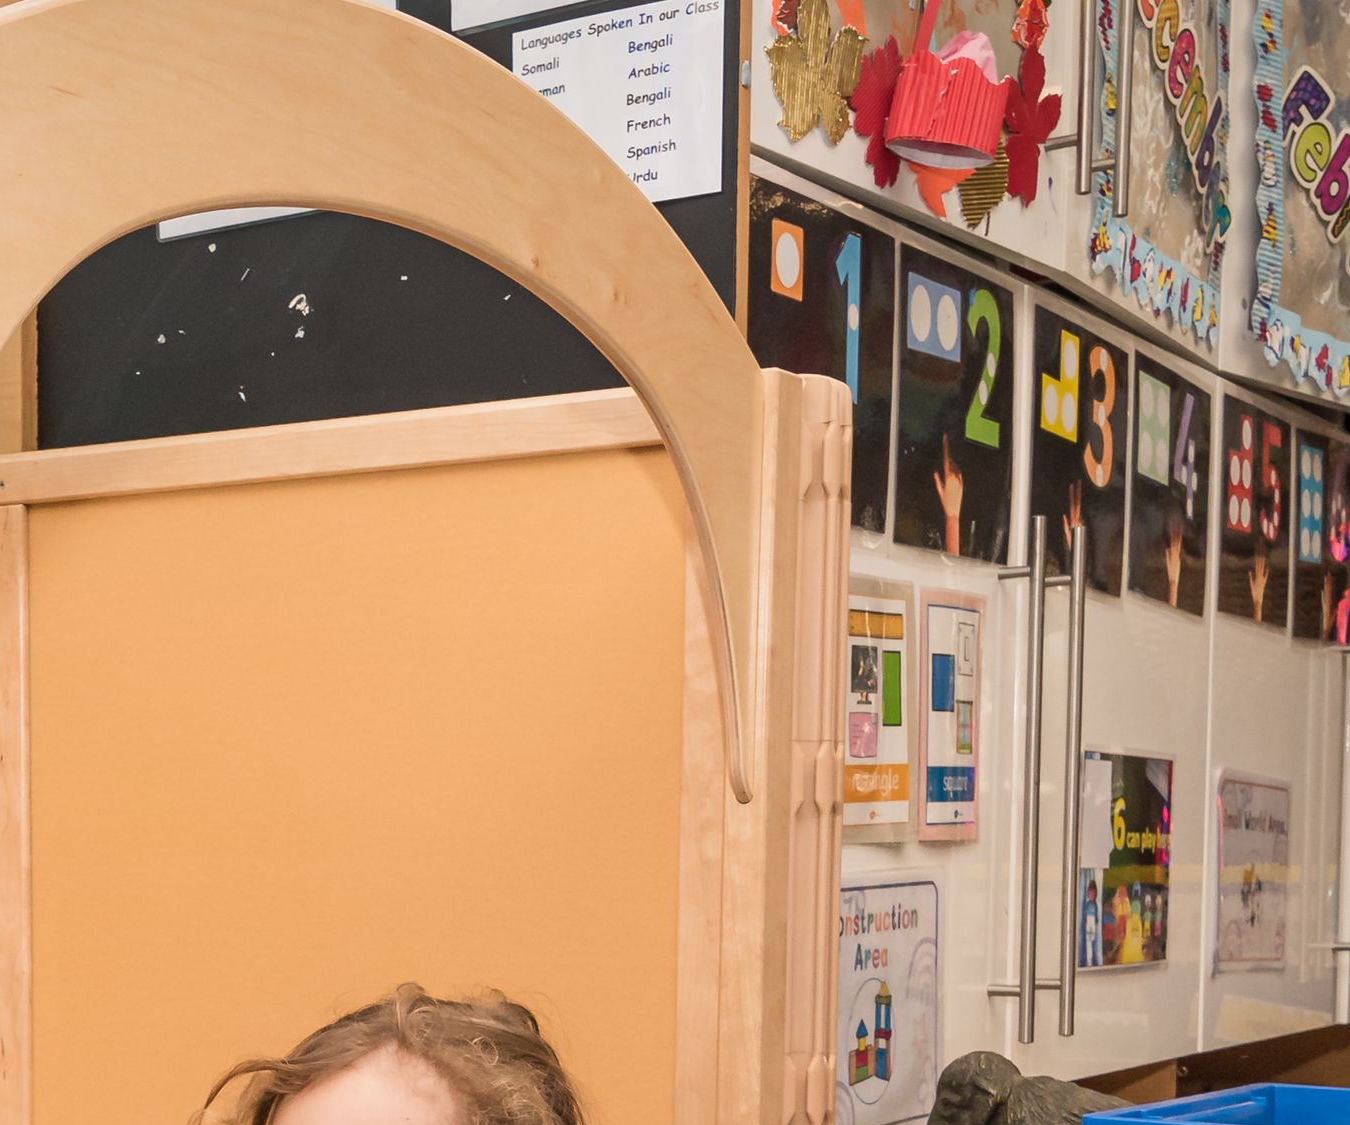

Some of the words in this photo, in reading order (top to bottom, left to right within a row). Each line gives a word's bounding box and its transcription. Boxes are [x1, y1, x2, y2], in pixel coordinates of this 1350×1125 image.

[521, 27, 582, 51] Languages
[587, 17, 633, 40] Spoken
[638, 12, 654, 27] In
[659, 8, 680, 22] our
[685, 1, 720, 15] Class
[628, 33, 674, 54] Bengali
[521, 57, 560, 76] Somali
[628, 61, 671, 79] Arabic
[537, 82, 566, 98] man
[626, 86, 672, 107] Bengali
[627, 113, 672, 133] French
[627, 139, 677, 161] Spanish
[1283, 69, 1350, 239] Feb
[835, 231, 863, 405] 1
[964, 288, 1002, 449] 2
[1083, 345, 1116, 488] 3
[1173, 392, 1198, 520] 4
[1260, 420, 1282, 541] 5
[1113, 797, 1126, 850] 6
[1126, 832, 1140, 848] can
[1141, 825, 1156, 854] play
[840, 902, 919, 938] onstruction
[853, 942, 889, 972] Area
